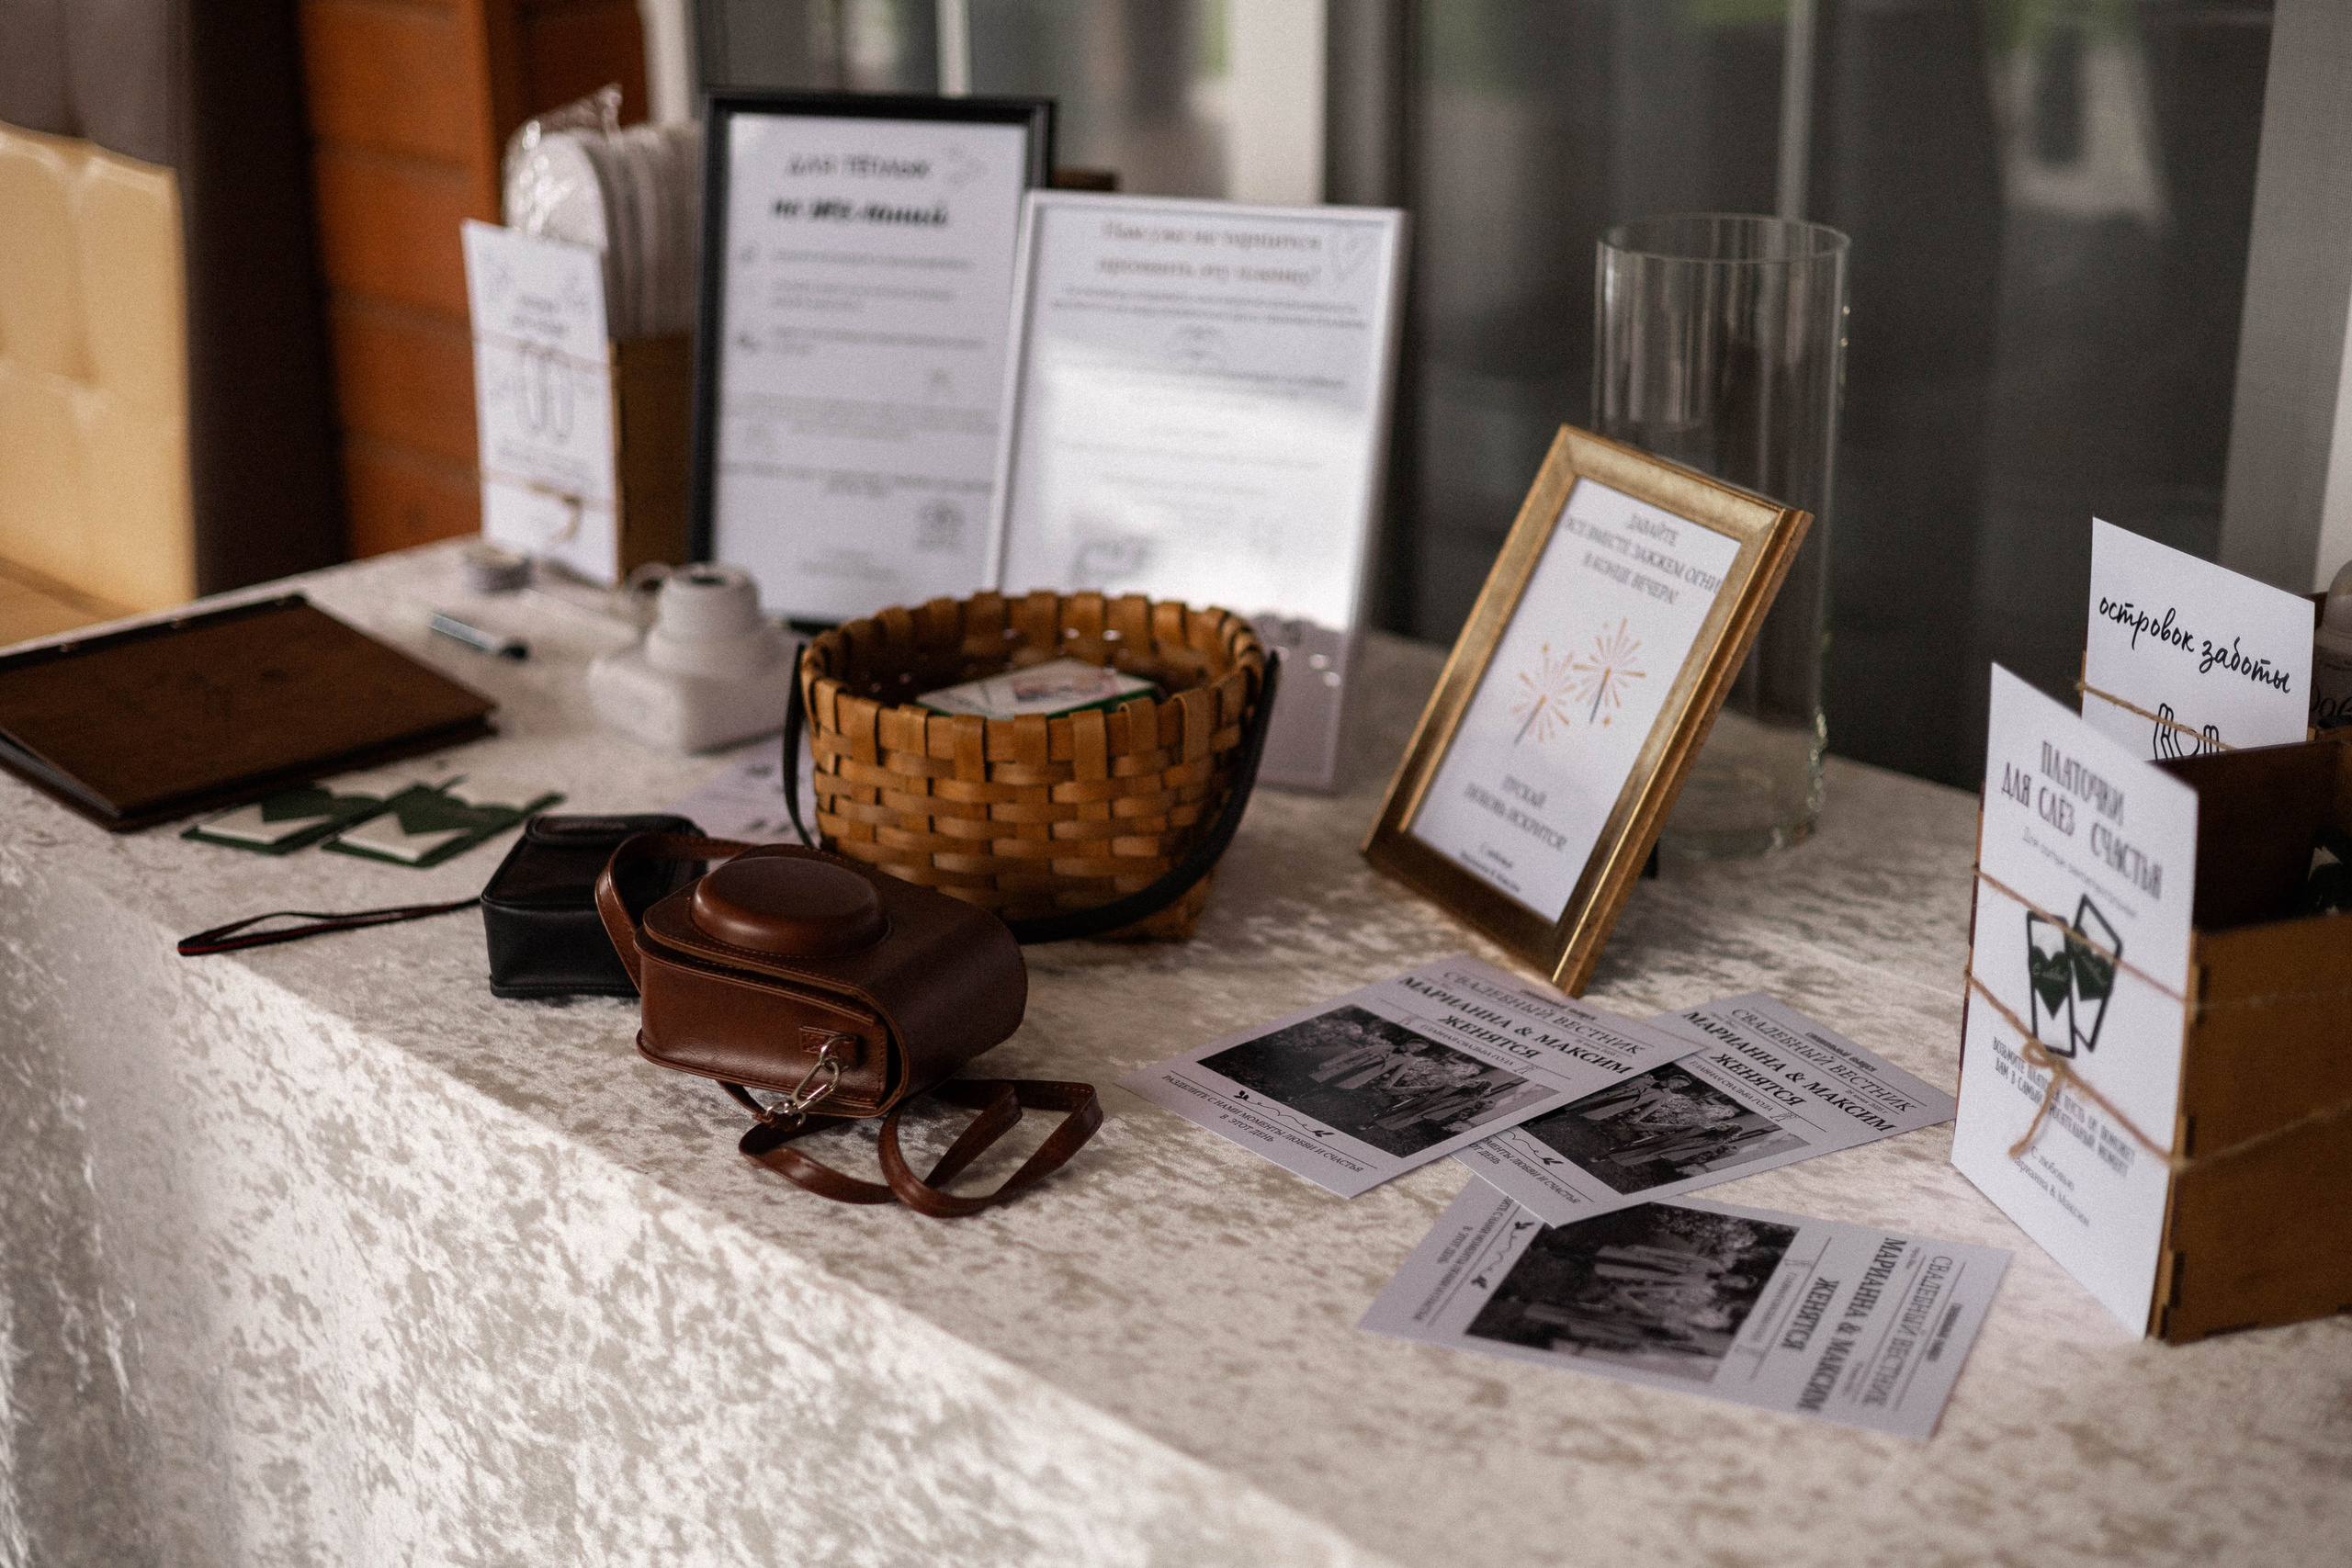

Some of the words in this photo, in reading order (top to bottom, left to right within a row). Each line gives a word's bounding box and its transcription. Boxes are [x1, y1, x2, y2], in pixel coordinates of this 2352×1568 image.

[2098, 596, 2196, 651] островок
[2199, 636, 2291, 694] заботы
[2001, 761, 2031, 808] ДЛЯ
[2090, 822, 2164, 900] СЧАСТЬЯ
[1398, 976, 1513, 1030] МАРИАННА
[1513, 1024, 1533, 1038] &
[1534, 1032, 1635, 1076] МАКСИМ
[1437, 1014, 1544, 1060] ЖЕНЯТСЯ
[1553, 1013, 1647, 1055] ВЕСТНИК
[1731, 1009, 1834, 1066] СВАДЕБНЫЙ
[1829, 1064, 1917, 1112] ВЕСТНИК
[1681, 1011, 1787, 1072] МАРИАННА
[1785, 1071, 1804, 1083] &
[1803, 1080, 1897, 1133] МАКСИМ
[1710, 1053, 1807, 1106] ЖЕНЯТСЯ
[1162, 1075, 1208, 1100] РАЗДЕЛИТЕ
[1214, 1100, 1241, 1115] НАМИ
[1240, 1112, 1286, 1136] МОМЕНТЫ
[1284, 1134, 1317, 1152] ЛЮБВИ
[1323, 1152, 1364, 1173] СЧАСТЬЯ
[1228, 1117, 1253, 1131] ЭТОТ
[1250, 1128, 1276, 1143] ДЕНЬ
[1477, 1150, 1501, 1165] ДЕНЬ
[1481, 1137, 1515, 1159] ОМЕНТЫ
[1544, 1180, 1580, 1204] СЧАСТЬЯ
[1781, 1276, 1840, 1351] ЖЕНЯТСЯ
[1844, 1236, 1907, 1318] МАРИАННА
[1899, 1255, 1953, 1337] СВАДЕБНЫЙ
[1838, 1321, 1861, 1336] &
[1794, 1337, 1856, 1413] МАКСИМ
